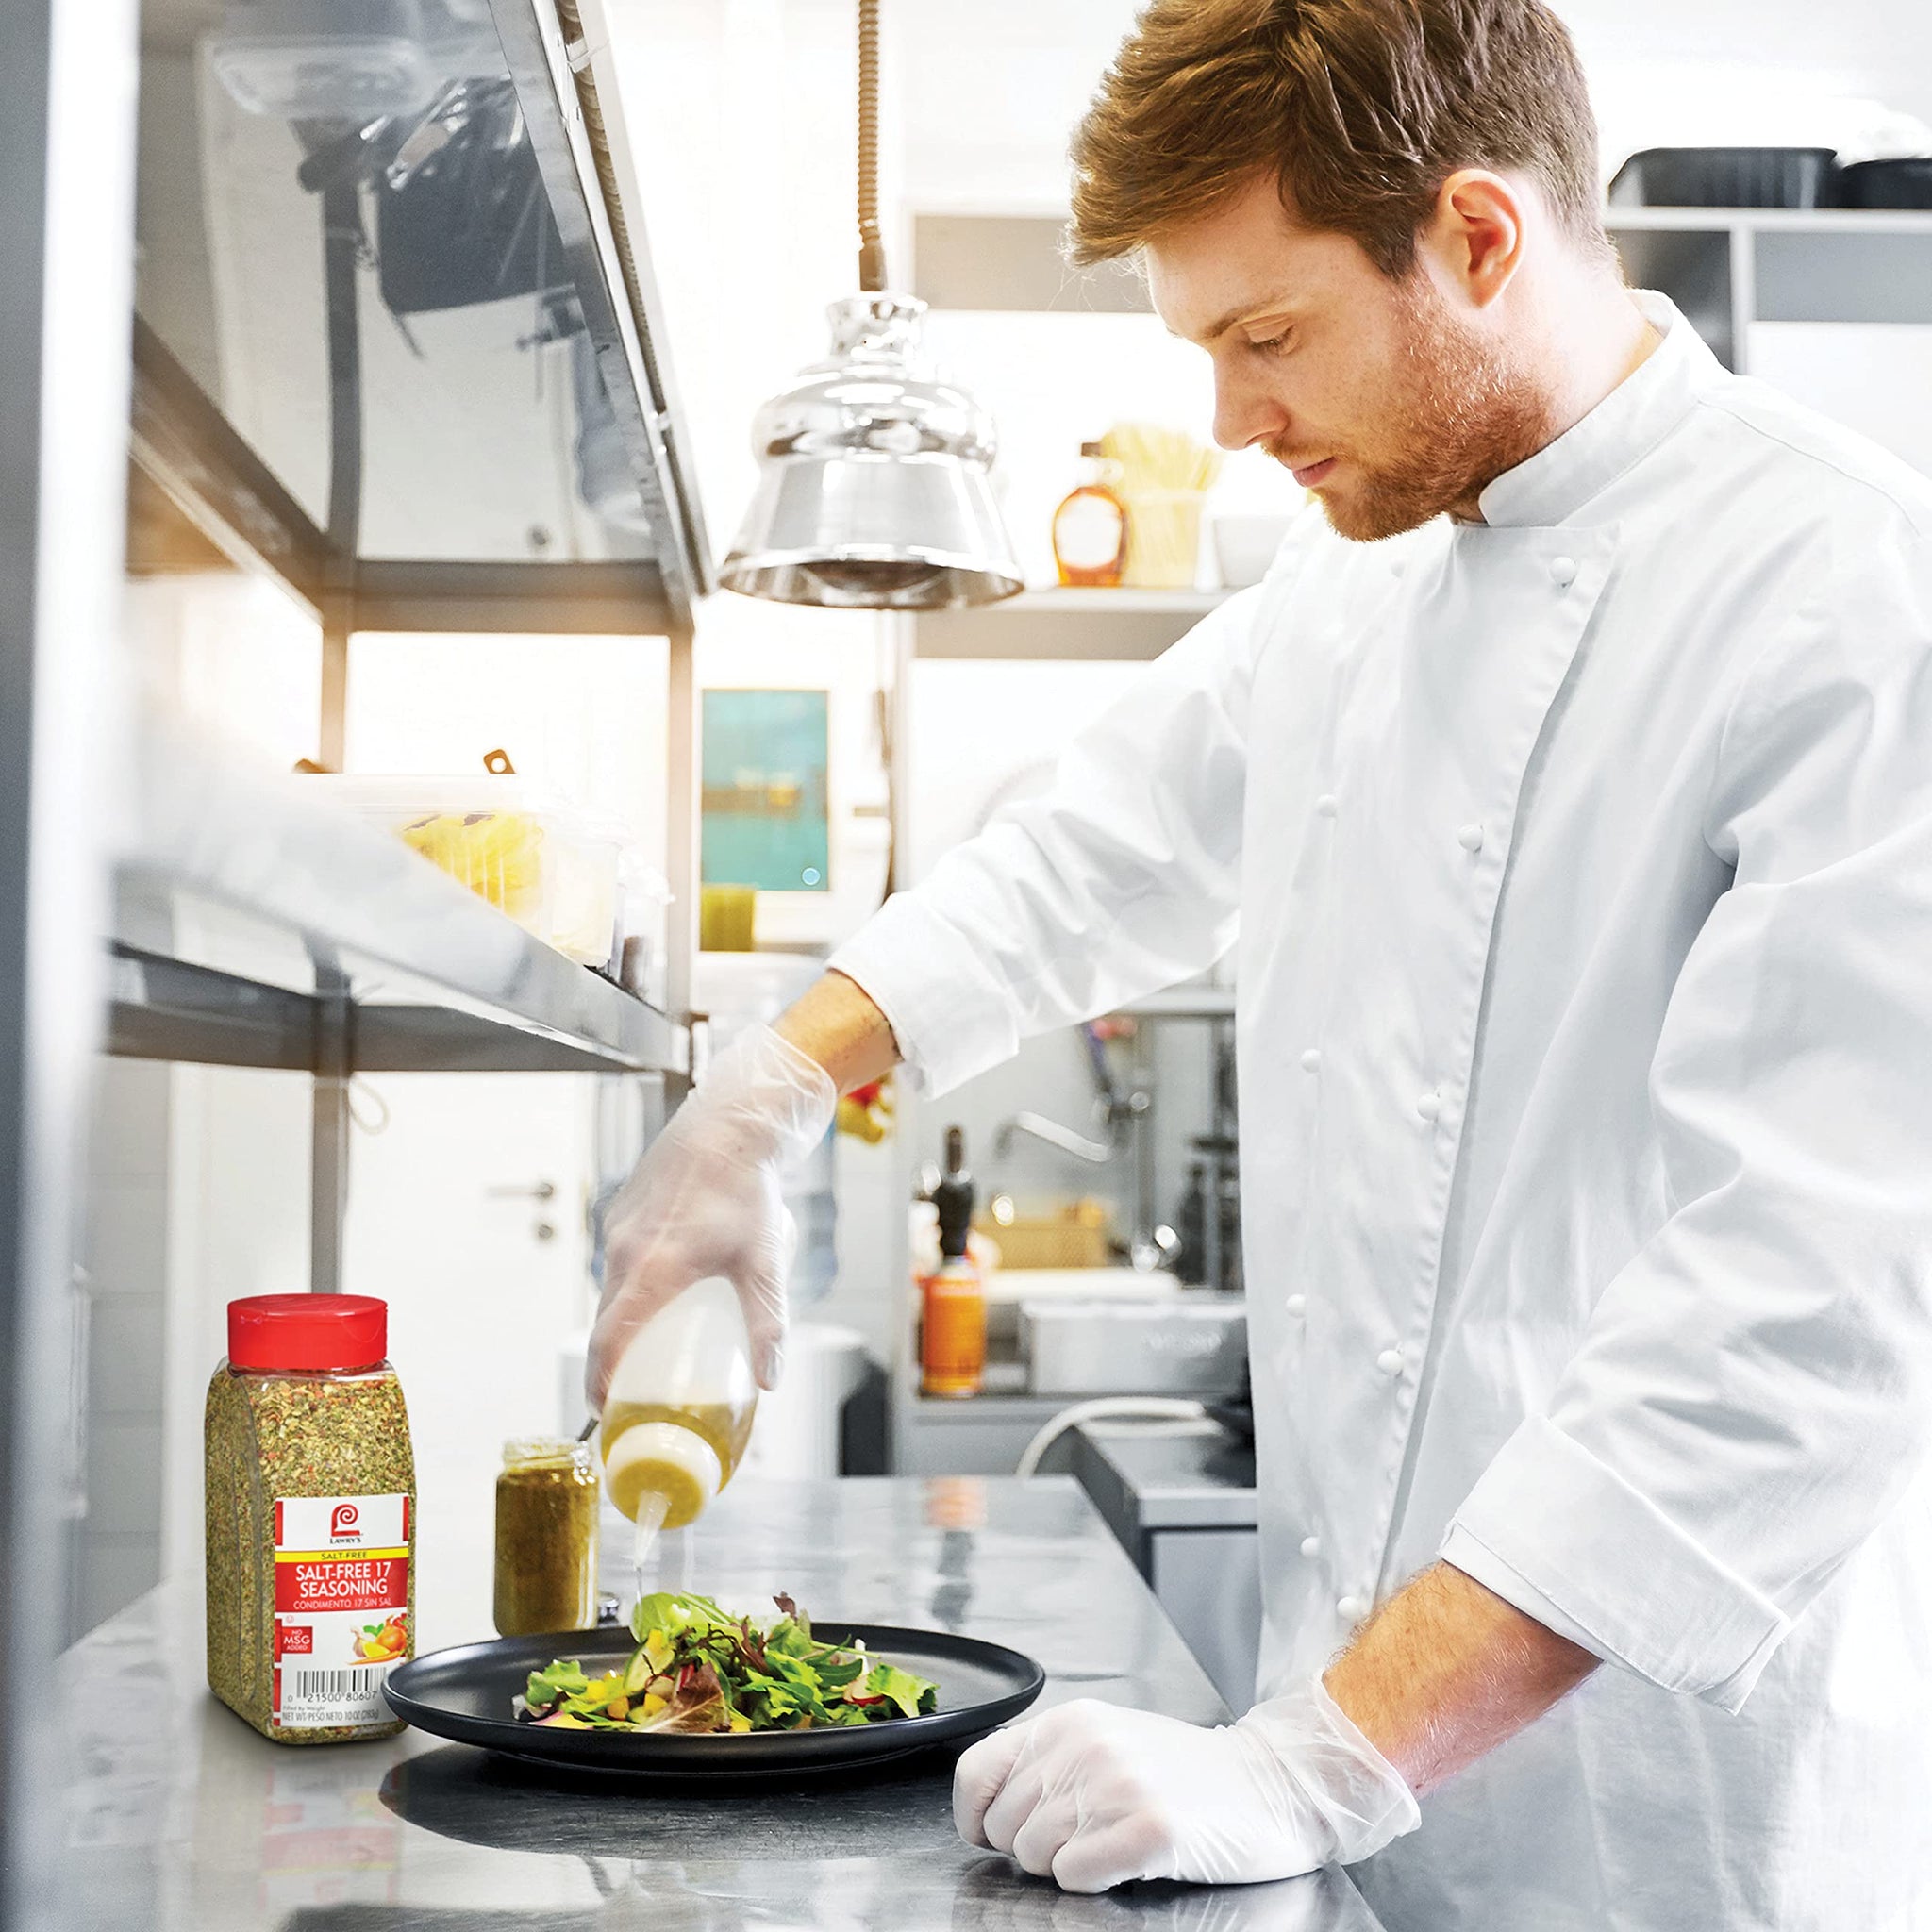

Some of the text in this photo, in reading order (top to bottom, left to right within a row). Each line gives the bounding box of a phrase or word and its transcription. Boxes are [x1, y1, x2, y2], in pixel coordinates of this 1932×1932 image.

[321, 1551, 368, 1560] SALT-FREE
[295, 1561, 392, 1581] SALT-FREE 17
[299, 1578, 388, 1598] SEASONING
[293, 1596, 392, 1610] CONDIMENTO 17 SIN SAL
[283, 1635, 310, 1644] MSG
[308, 1692, 341, 1702] 21500
[345, 1690, 377, 1702] 80607
